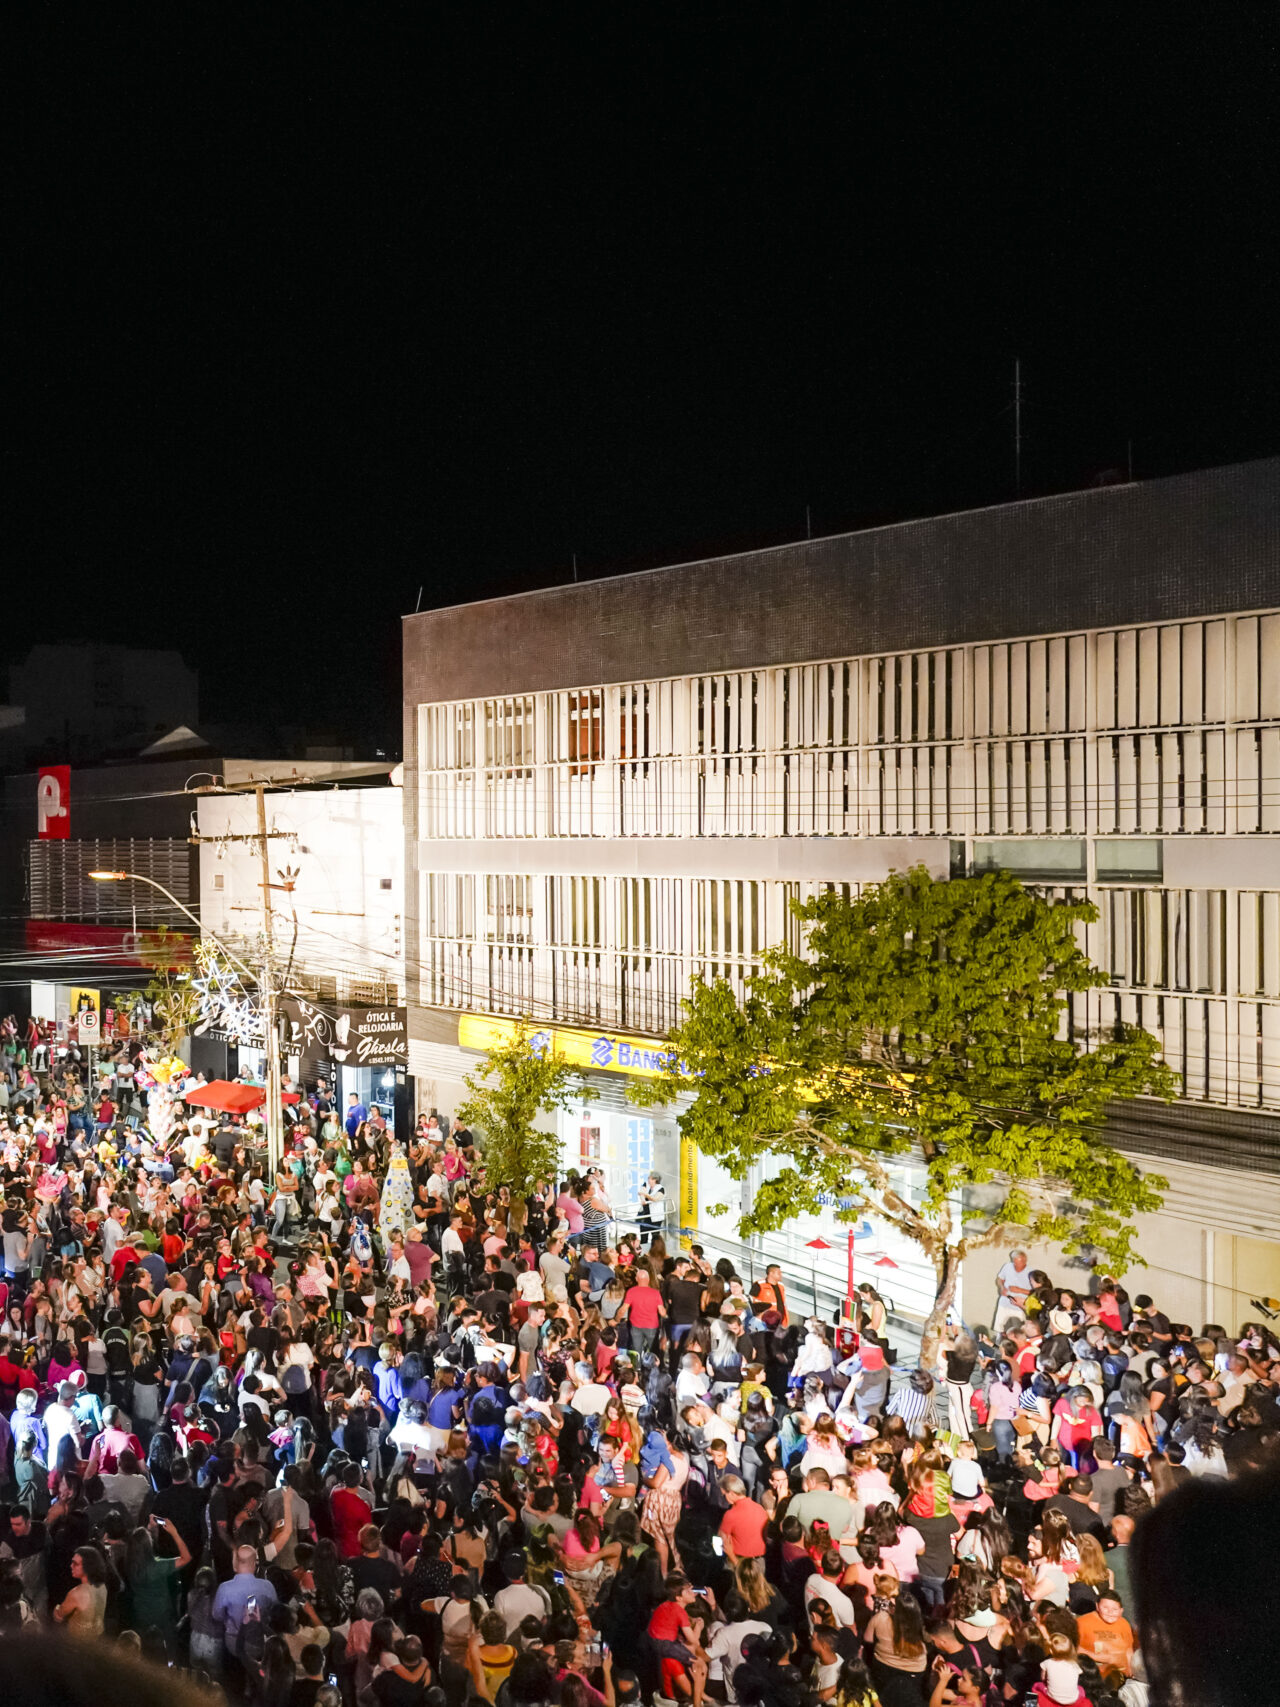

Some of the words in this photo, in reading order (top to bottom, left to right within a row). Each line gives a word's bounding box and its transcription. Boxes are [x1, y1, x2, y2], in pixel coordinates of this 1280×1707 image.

[85, 1014, 93, 1025] E
[366, 1011, 389, 1022] ÓTICA
[391, 1012, 396, 1021] E
[358, 1021, 404, 1034] RELOJOARIA
[356, 1036, 407, 1063] Ghesla
[686, 1144, 694, 1216] Autoatendimento
